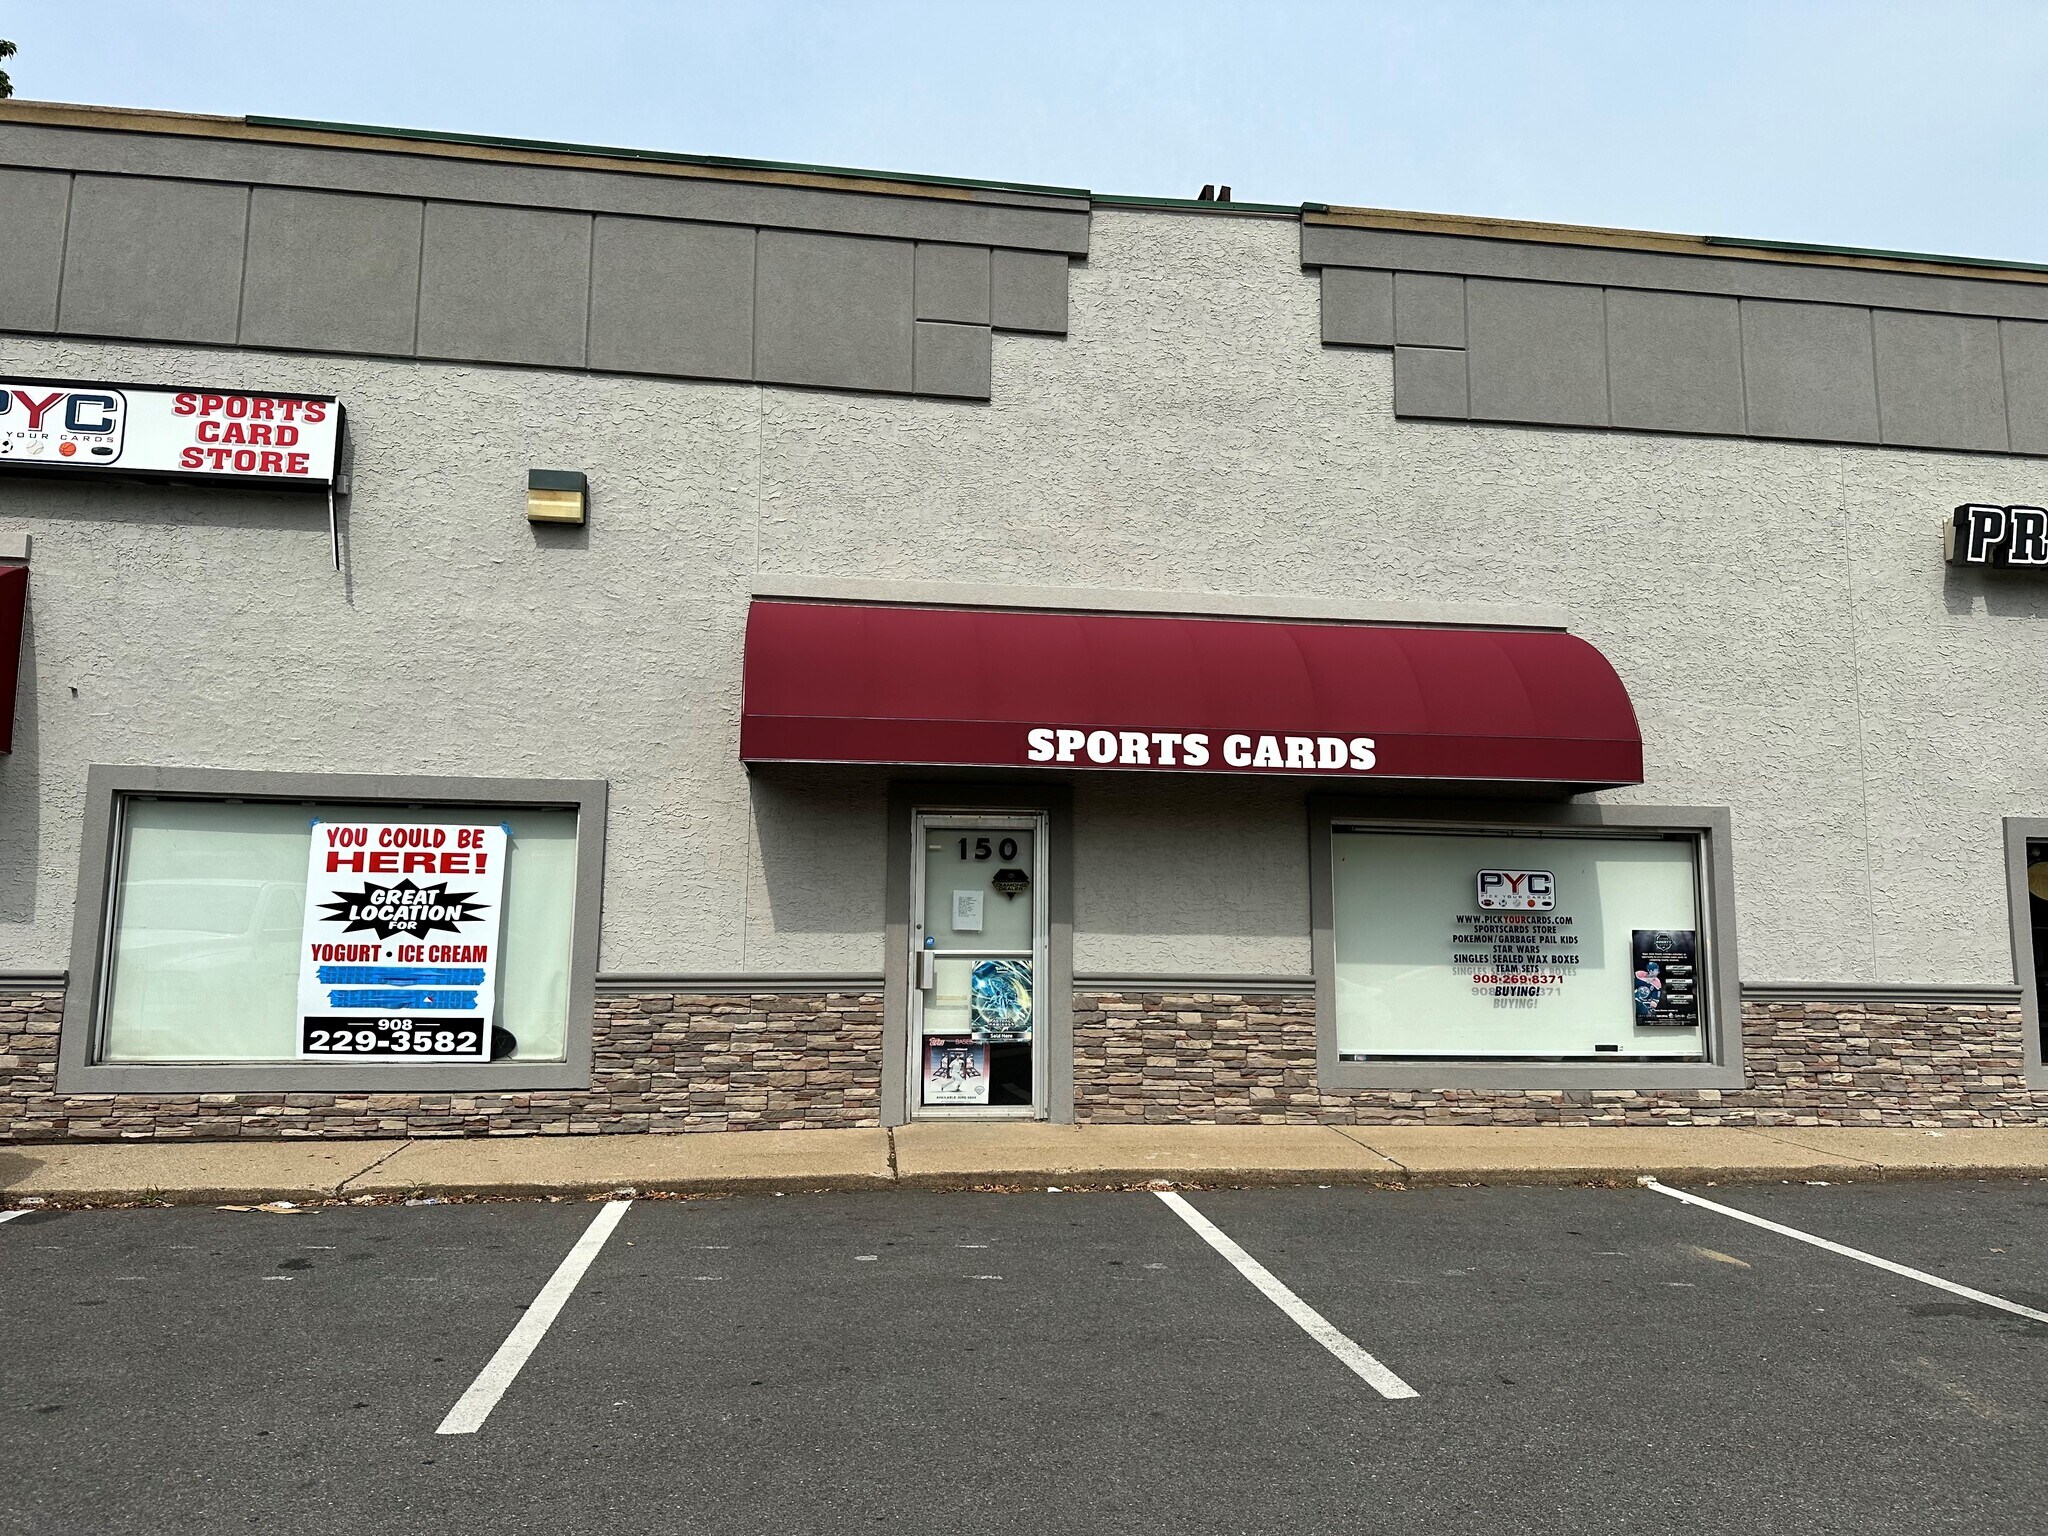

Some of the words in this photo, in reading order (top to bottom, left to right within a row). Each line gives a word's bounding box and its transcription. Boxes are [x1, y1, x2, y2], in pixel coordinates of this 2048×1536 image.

[173, 392, 327, 423] SPORTS
[6, 431, 49, 440] YOUR
[60, 434, 114, 443] CARDS
[197, 421, 299, 447] CARD
[180, 446, 310, 474] STORE
[1027, 728, 1210, 767] SPORTS
[1223, 734, 1376, 770] CARDS
[327, 827, 368, 848] YOU
[379, 828, 446, 848] COULD
[457, 829, 485, 849] BE
[958, 837, 1018, 861] 150
[326, 851, 488, 874] HERE!
[1480, 873, 1552, 895] PYC
[370, 889, 440, 905] GREAT
[349, 904, 463, 921] LOCATION
[1456, 915, 1573, 925] WWW.PICKYOURCARDS.COM
[388, 921, 417, 930] FOR
[1474, 925, 1529, 934] SPORTSCARDS
[1532, 926, 1557, 934] STORE
[1453, 935, 1536, 944] POKEMON/GARBAGE
[1539, 936, 1557, 944] PAIL
[1560, 936, 1579, 944] KIDS
[311, 944, 382, 962] YOGURT
[397, 945, 425, 962] ICE
[428, 945, 488, 963] CREAM
[1493, 945, 1513, 953] STAR
[1516, 945, 1540, 954] WARS
[1453, 954, 1489, 963] SINGLES
[1492, 955, 1523, 964] SEALED
[1527, 955, 1548, 964] WAX
[1551, 955, 1579, 964] BOXES
[1496, 964, 1519, 973] TEAM
[1521, 964, 1539, 973] SETS
[1494, 986, 1540, 997] BUYING!
[377, 1019, 413, 1031] 908
[309, 1030, 477, 1053] 229-3582
